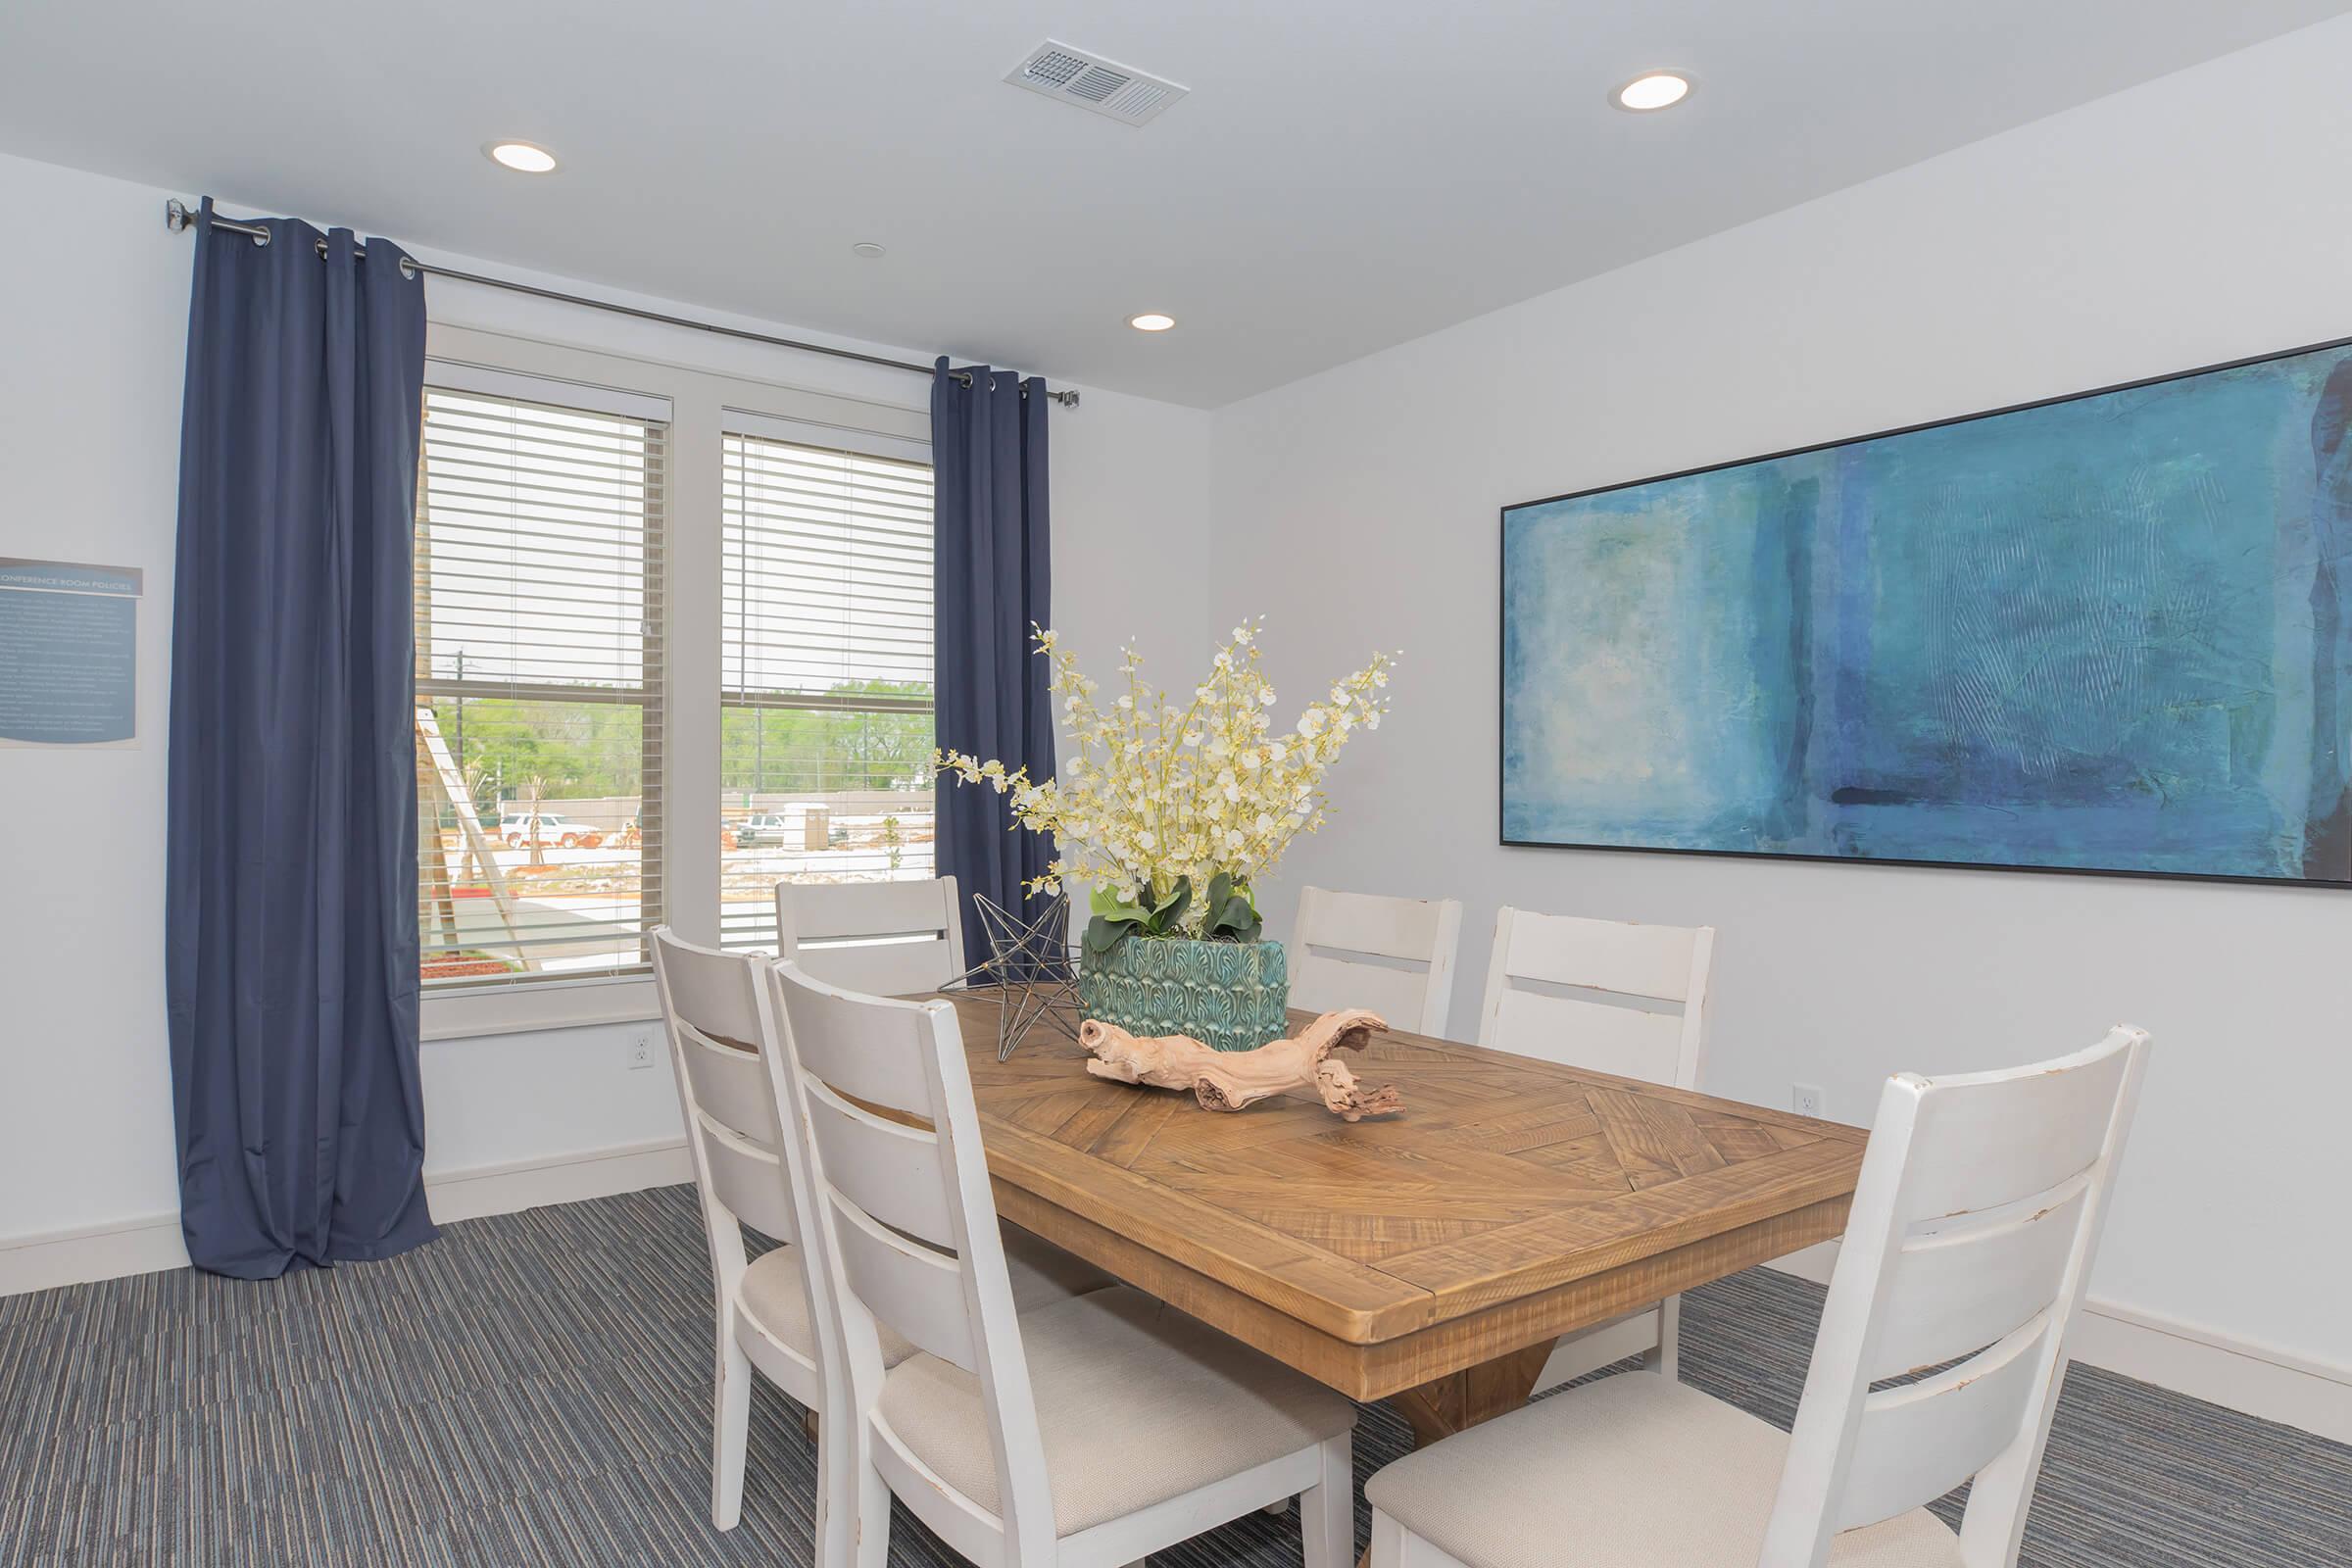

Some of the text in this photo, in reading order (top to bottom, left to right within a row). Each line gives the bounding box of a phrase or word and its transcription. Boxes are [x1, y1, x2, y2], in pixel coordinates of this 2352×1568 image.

[0, 574, 132, 591] ONFERENCE ROOM POLICIES
